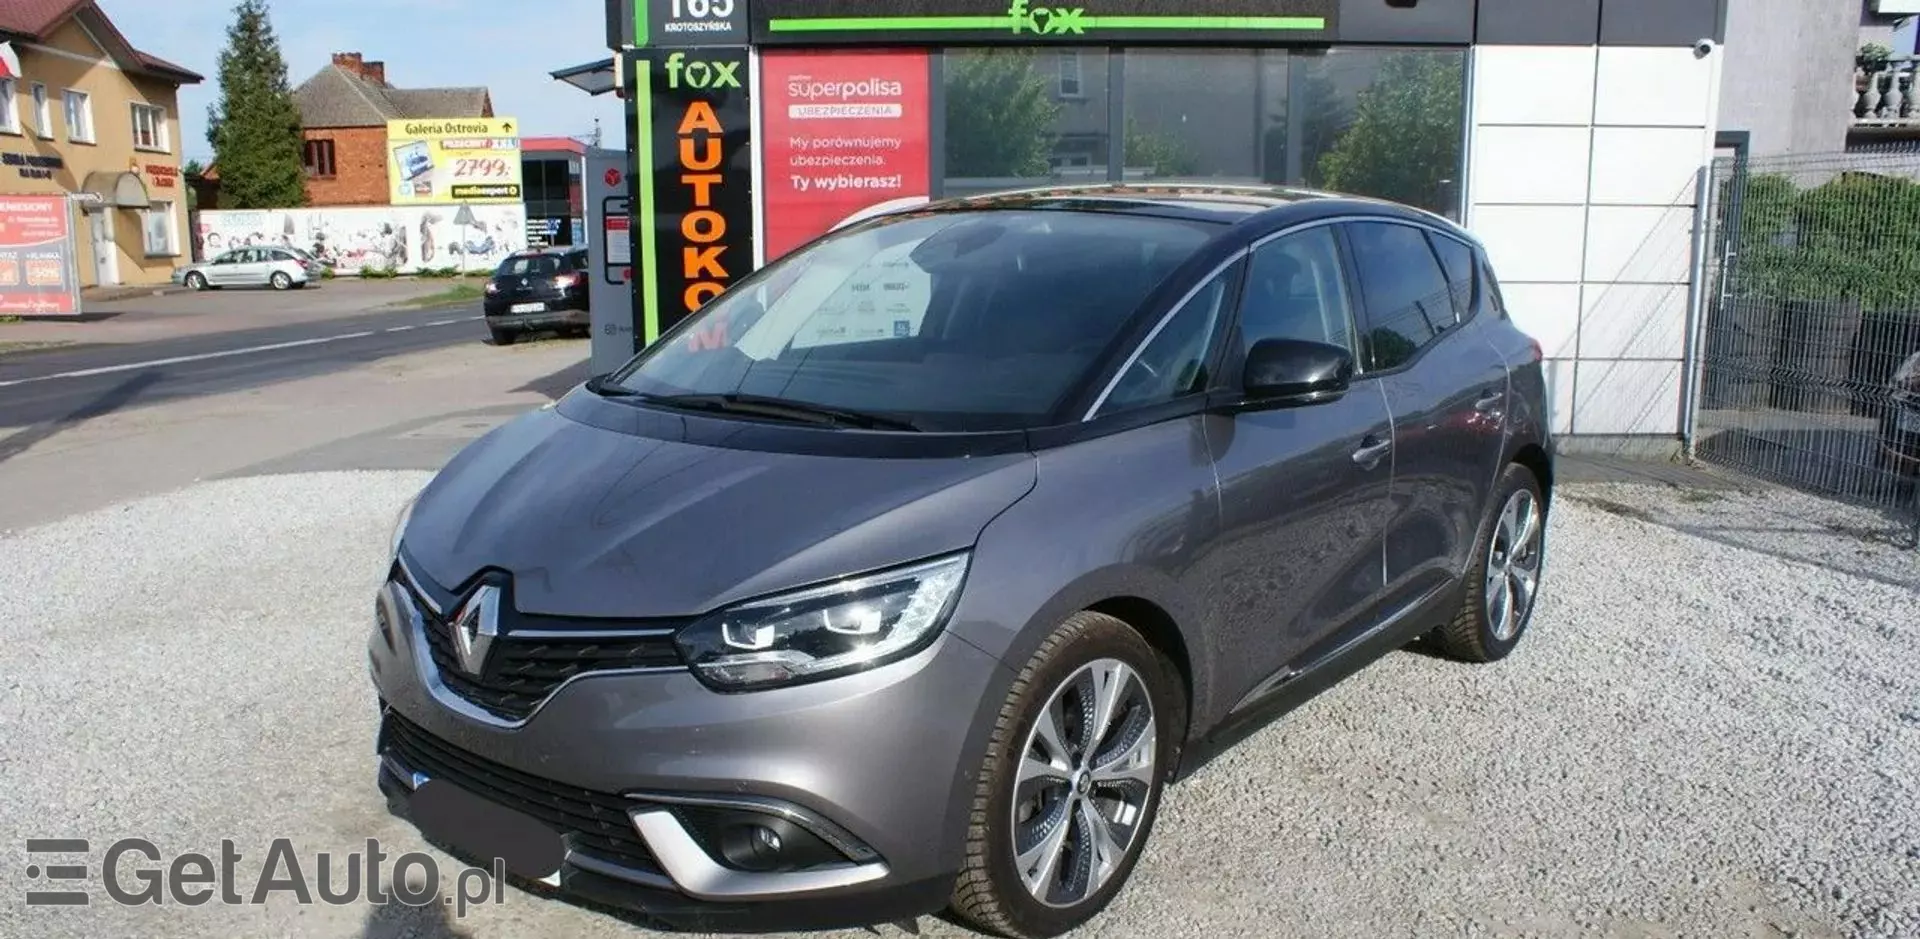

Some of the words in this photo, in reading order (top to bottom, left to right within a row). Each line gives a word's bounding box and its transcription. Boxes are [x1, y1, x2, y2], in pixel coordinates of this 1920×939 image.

[672, 0, 735, 18] 165
[1007, 0, 1086, 35] fox
[664, 20, 732, 33] KROTOSZYŃSKA
[664, 52, 742, 89] fox
[788, 78, 903, 101] superpolisa
[797, 106, 893, 116] UBEZPIECZENIA
[405, 122, 442, 135] Galeria
[444, 121, 488, 134] Ostrovia
[790, 137, 809, 150] My
[812, 136, 902, 150] porównujemy
[790, 154, 887, 168] ubezpieczenia.
[790, 175, 810, 192] Ty
[814, 174, 903, 191] wybierasz!
